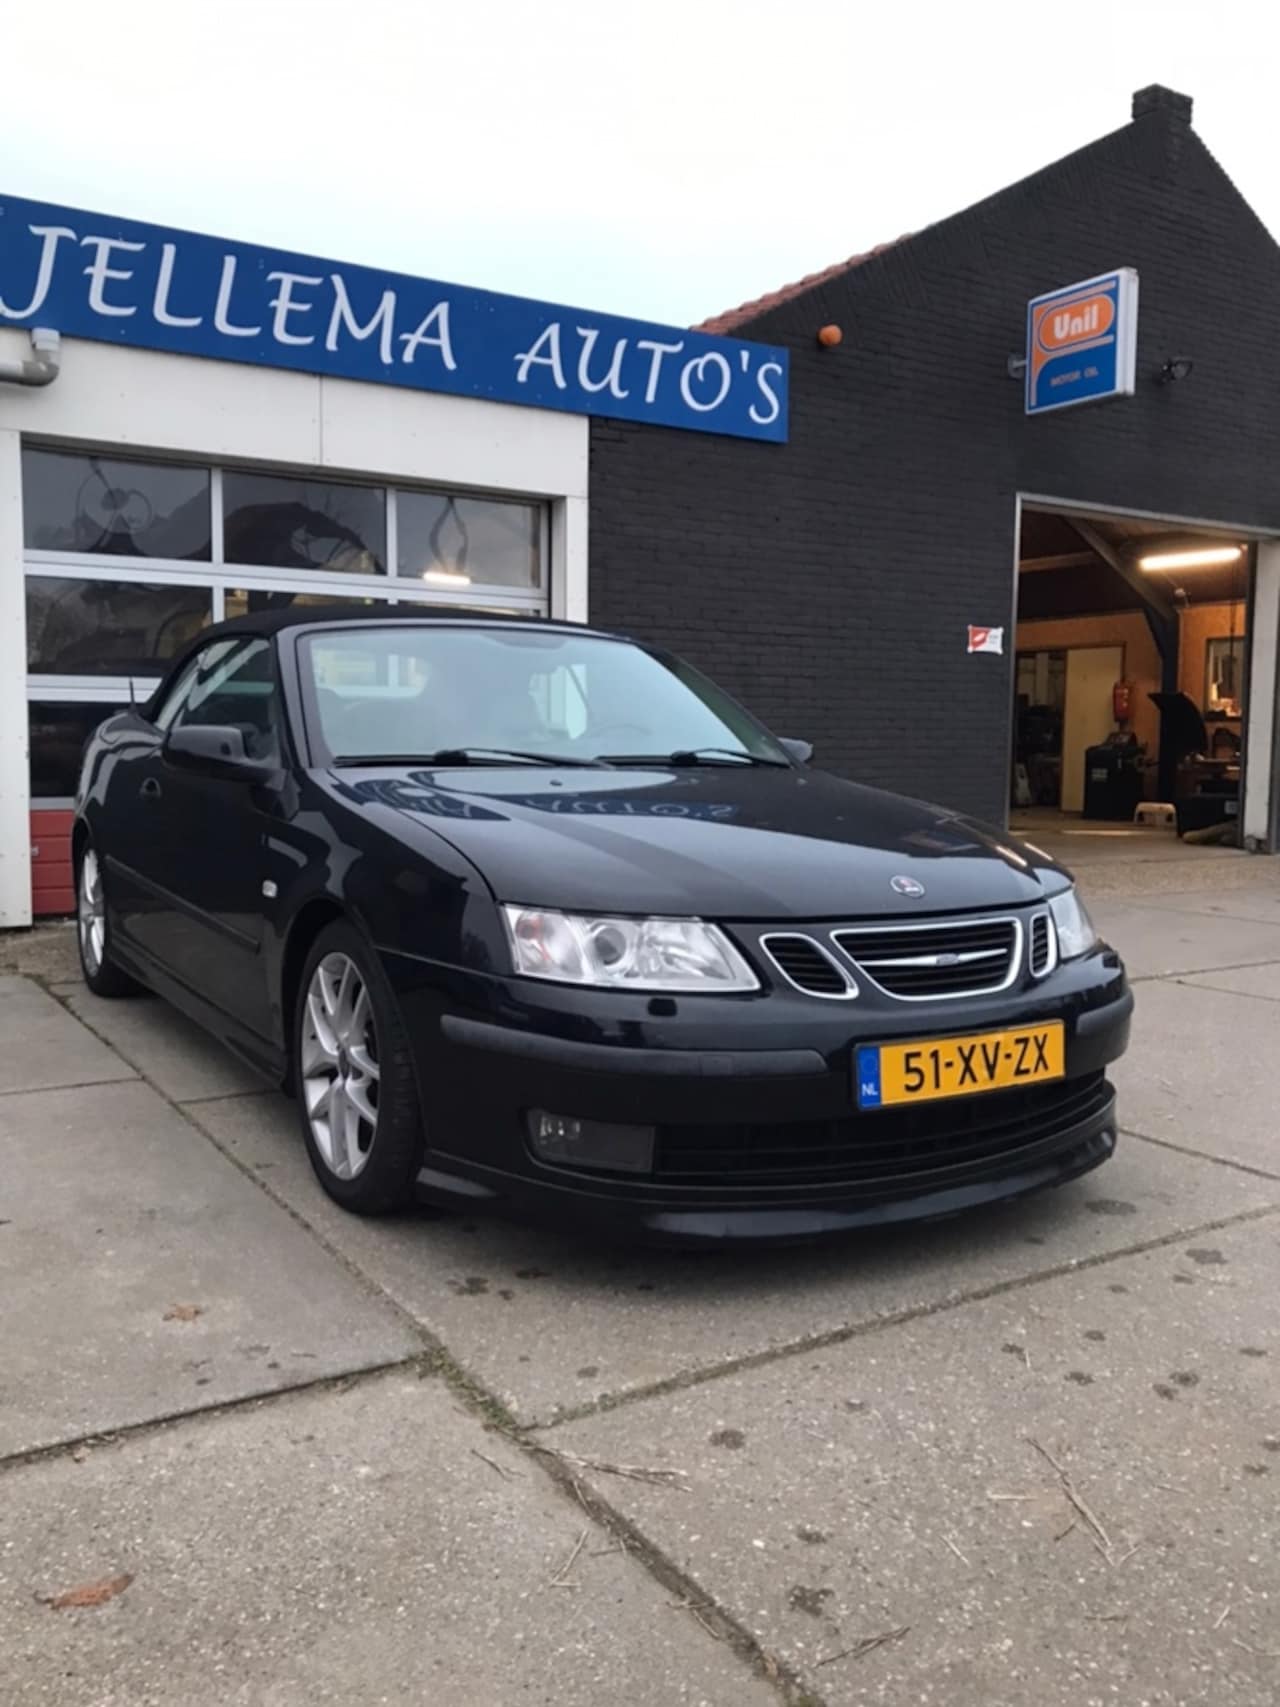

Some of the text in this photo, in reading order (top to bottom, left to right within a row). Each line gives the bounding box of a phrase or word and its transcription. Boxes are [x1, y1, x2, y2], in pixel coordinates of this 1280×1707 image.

[0, 224, 784, 425] JELLEMA AUTO'S
[1053, 303, 1099, 340] Unil
[903, 1033, 1049, 1093] 51-XV-ZX
[861, 1082, 879, 1097] NL
